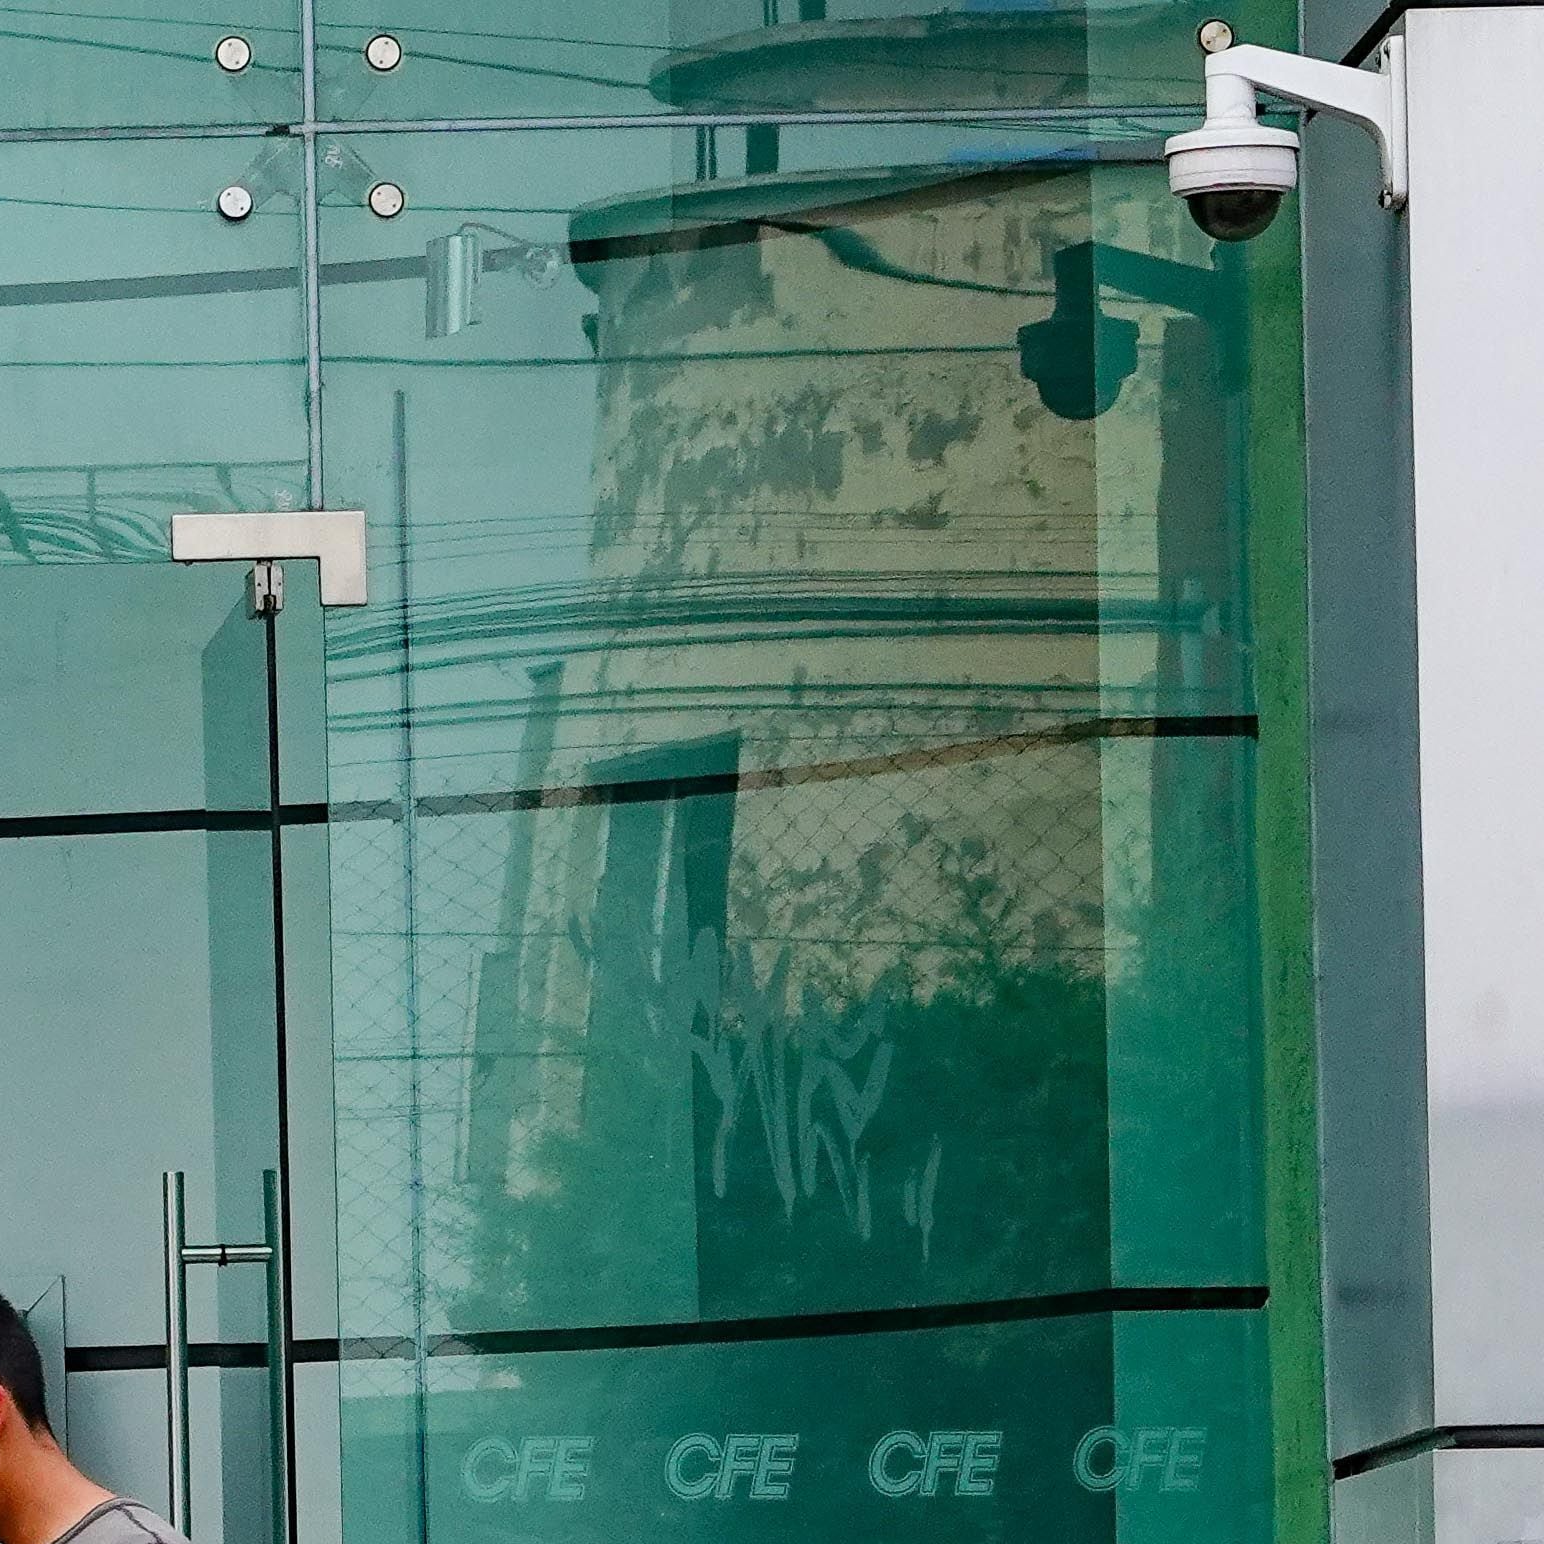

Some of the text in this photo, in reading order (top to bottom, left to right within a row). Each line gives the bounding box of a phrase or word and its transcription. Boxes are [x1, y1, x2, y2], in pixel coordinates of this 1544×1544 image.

[460, 1425, 1208, 1503] CFE CFE CFE CFE
